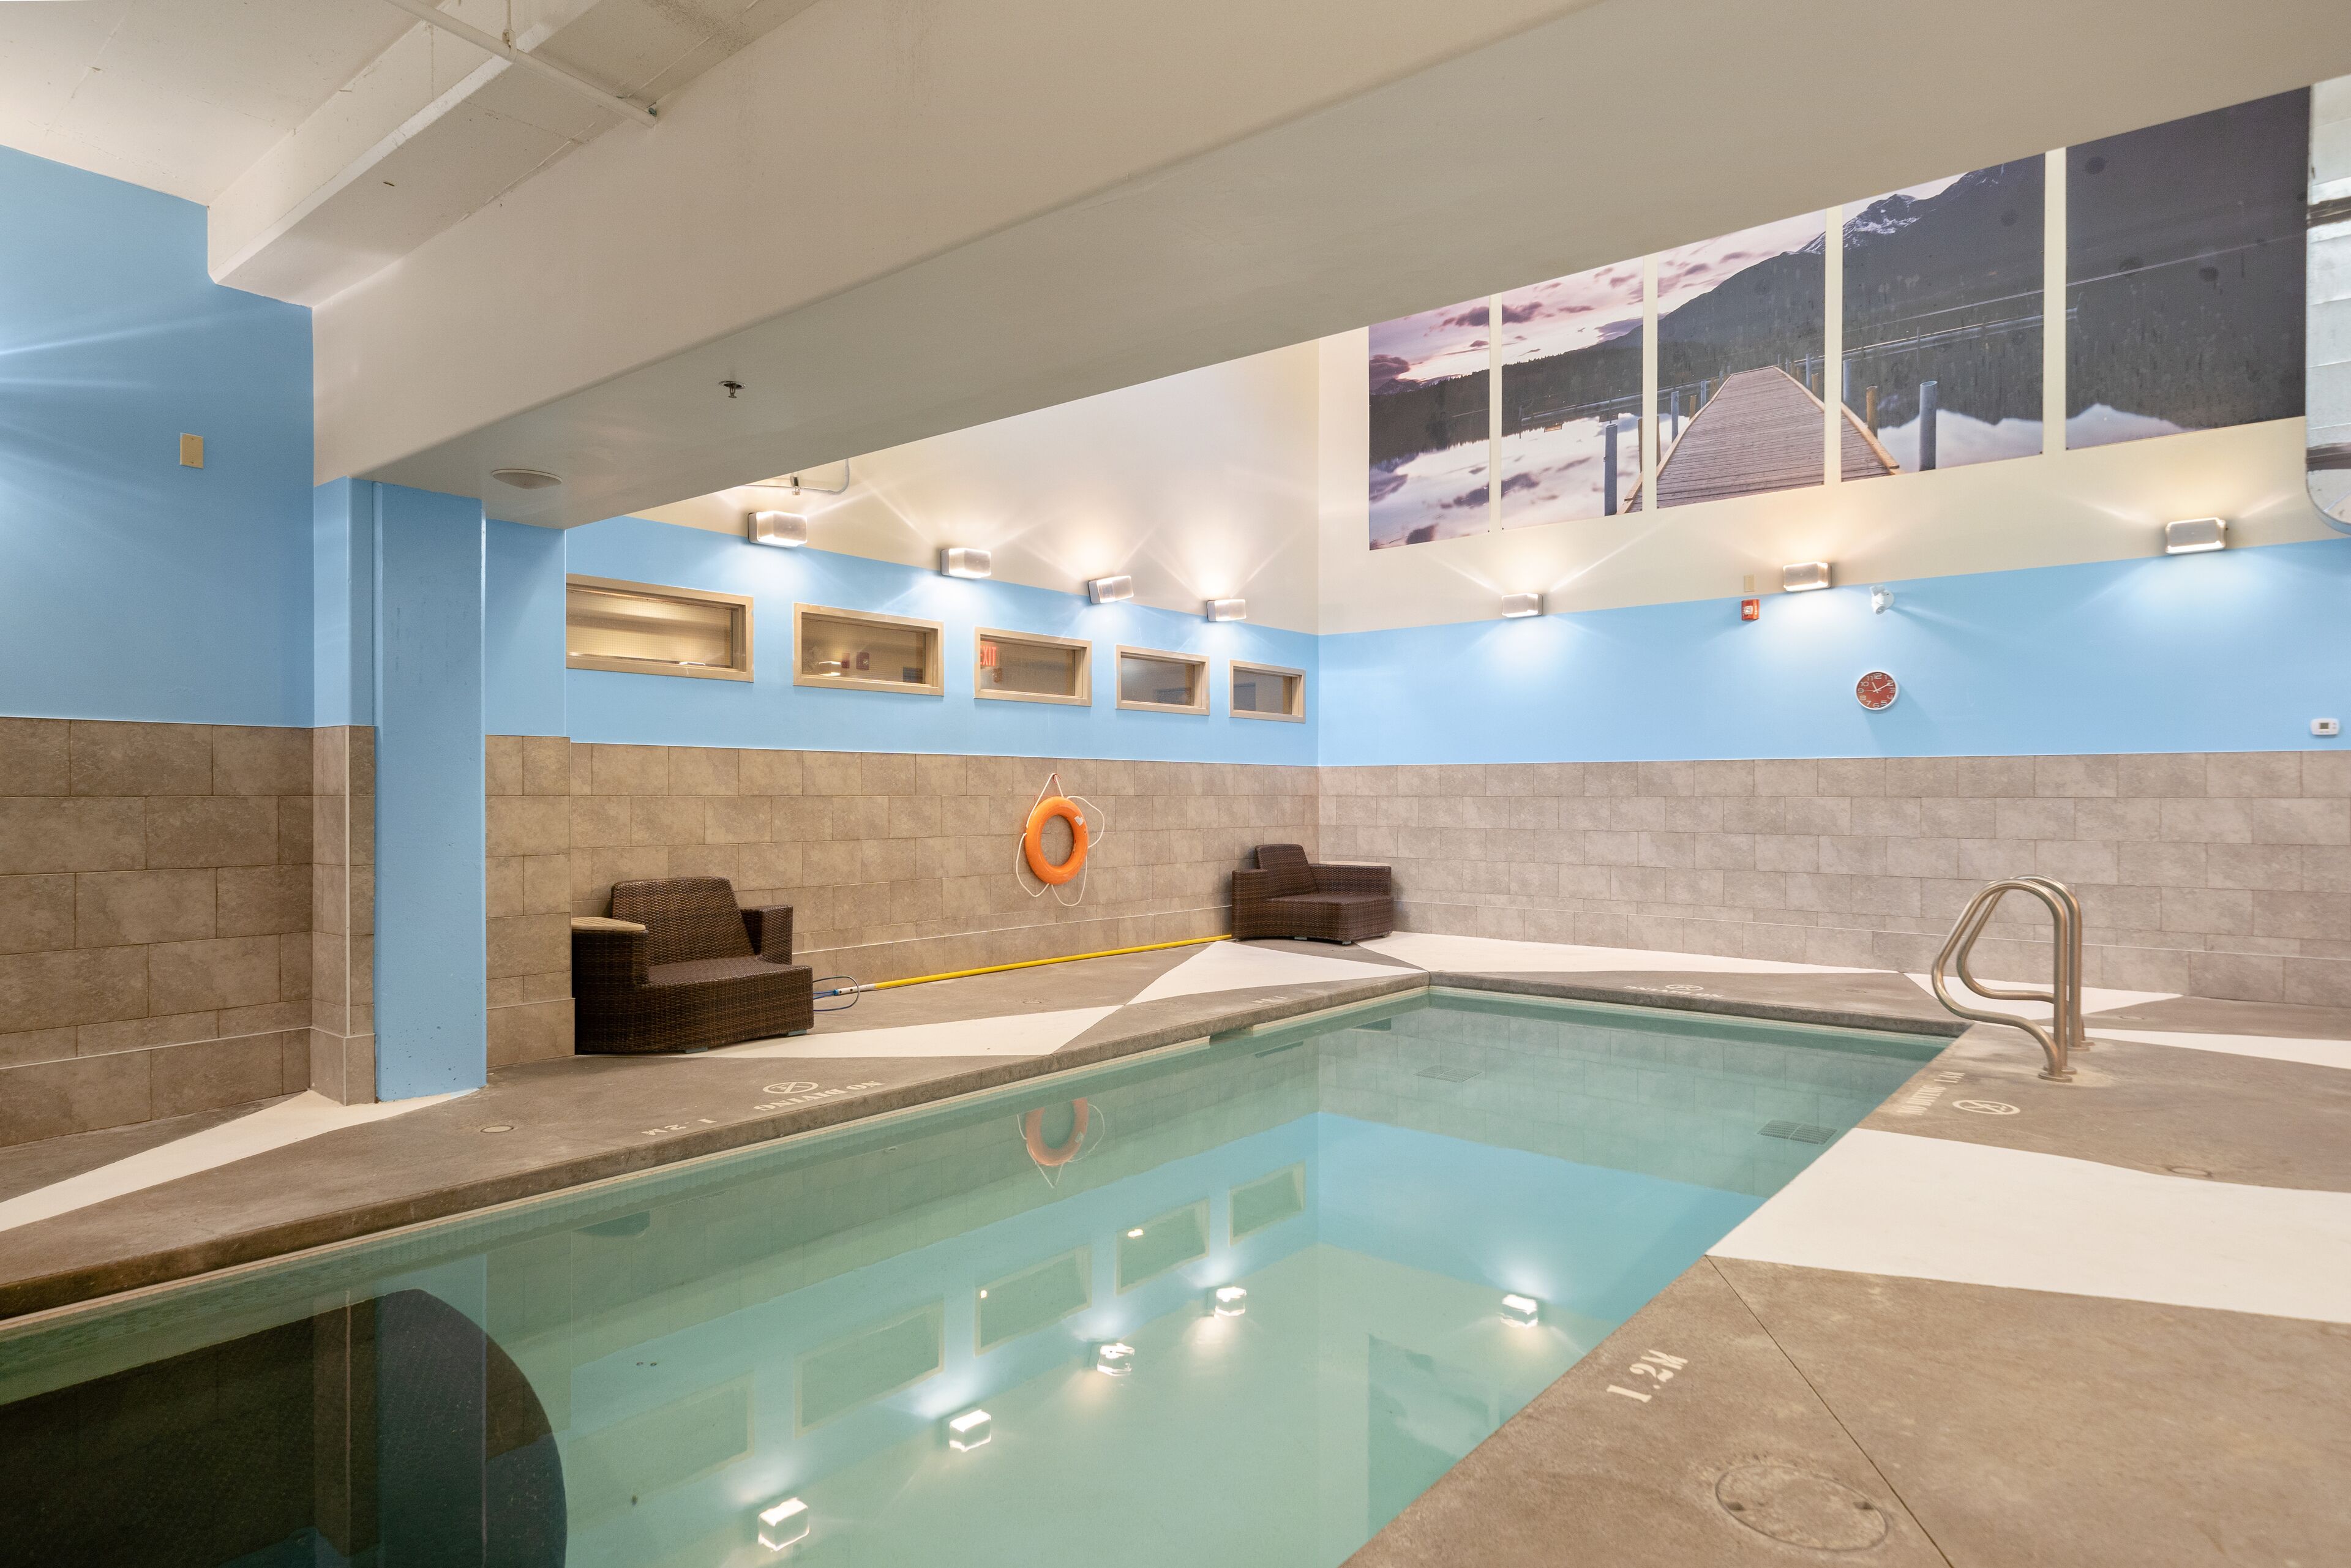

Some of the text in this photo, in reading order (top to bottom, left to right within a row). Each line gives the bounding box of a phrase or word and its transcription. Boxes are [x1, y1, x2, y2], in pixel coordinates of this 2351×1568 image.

[641, 1081, 883, 1136] NO DIVING 1.2M
[1896, 1105, 1928, 1116] NO
[1905, 1085, 1947, 1106] DIVING
[1606, 1349, 1688, 1403] 1.2M
